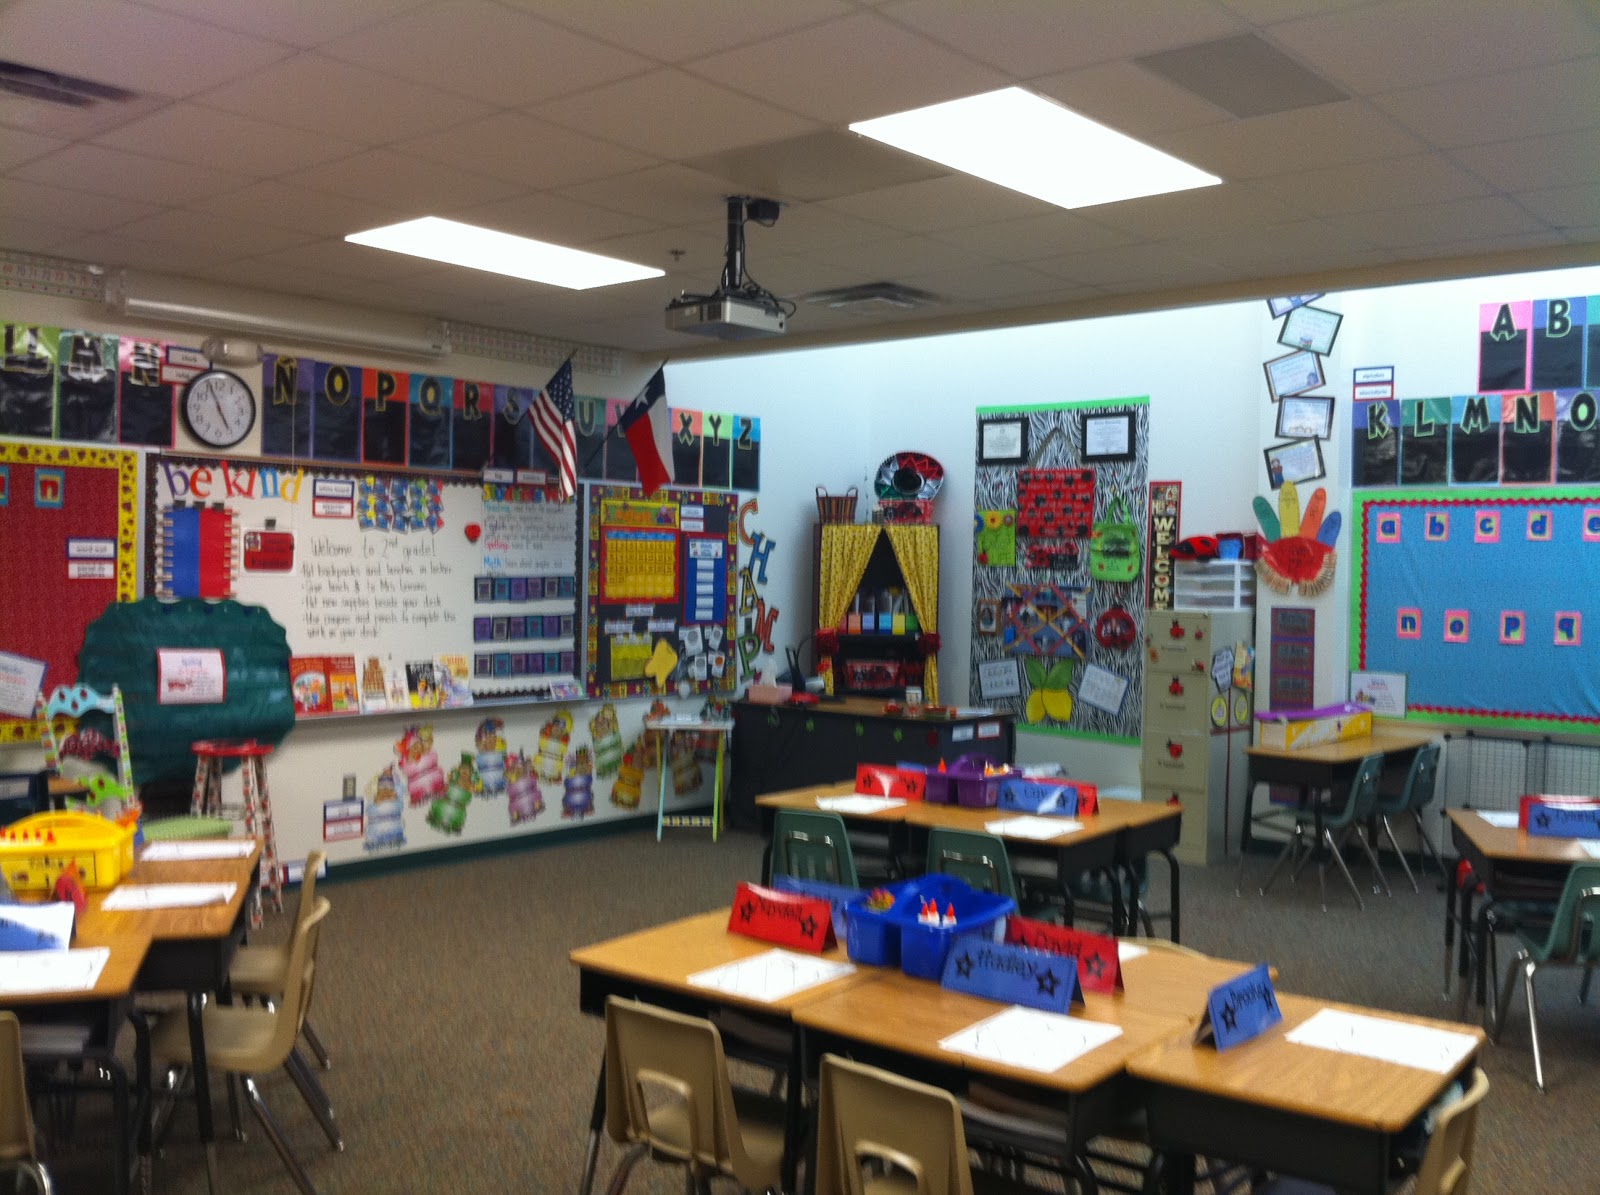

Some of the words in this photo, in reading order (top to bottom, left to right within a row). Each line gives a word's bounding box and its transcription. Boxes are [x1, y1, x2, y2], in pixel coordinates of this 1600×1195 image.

[1490, 303, 1518, 342] A
[1546, 298, 1571, 338] B
[325, 364, 350, 406] O
[375, 369, 396, 412] P
[463, 381, 482, 420] R
[503, 386, 522, 426] S
[679, 412, 694, 447] X
[708, 413, 722, 447] Y
[738, 417, 753, 450] Z
[1367, 400, 1389, 440] K
[1414, 400, 1435, 438] L
[1459, 395, 1491, 435] M
[1514, 392, 1540, 434] N
[1570, 391, 1598, 432] O
[163, 459, 212, 499] be
[1381, 520, 1396, 535] a
[1429, 515, 1444, 536] b
[1479, 517, 1494, 534] c
[1531, 515, 1547, 536] d
[1400, 616, 1416, 632] n
[1450, 619, 1464, 635] o
[1504, 616, 1520, 638] p
[1558, 617, 1575, 640] q
